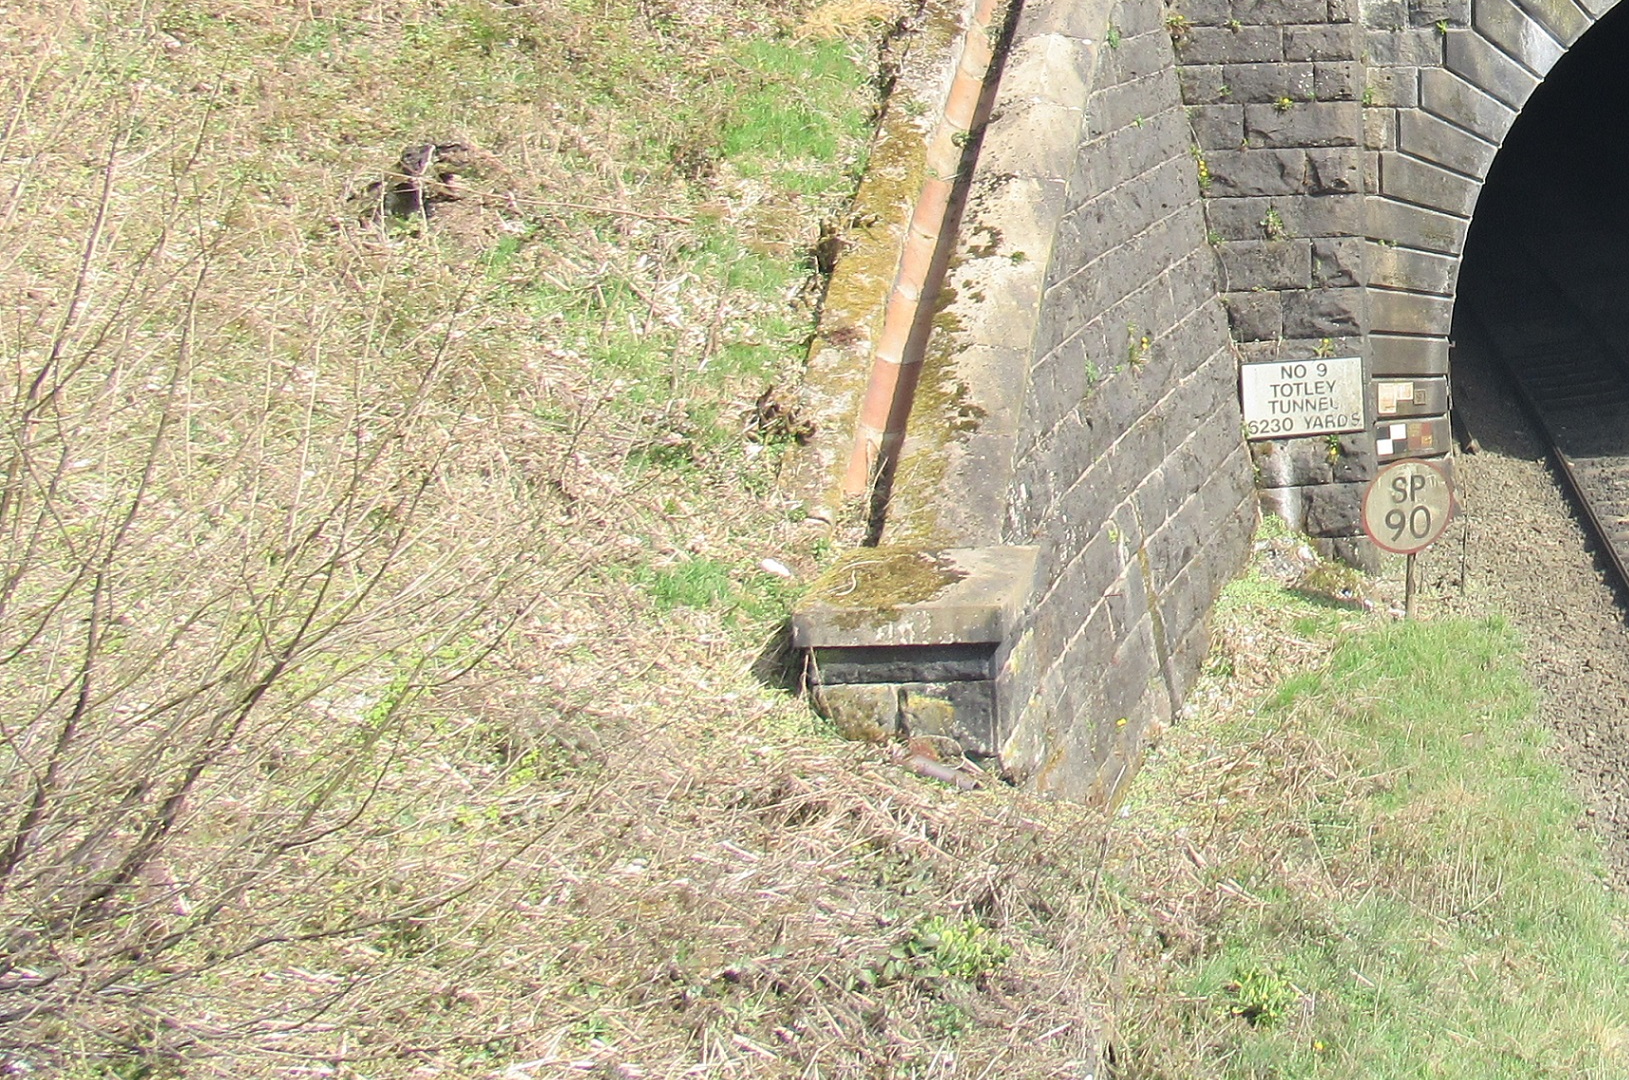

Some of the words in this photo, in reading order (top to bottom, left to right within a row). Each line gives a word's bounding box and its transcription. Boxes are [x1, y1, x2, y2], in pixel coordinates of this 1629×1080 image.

[1281, 364, 1307, 380] NO
[1316, 363, 1328, 378] 9
[1269, 380, 1337, 398] TOTLEY
[1268, 397, 1339, 415] TUNNEL
[1247, 417, 1294, 435] 6230
[1303, 412, 1361, 430] YARDS
[1392, 474, 1426, 504] SP
[1385, 505, 1432, 542] 90
